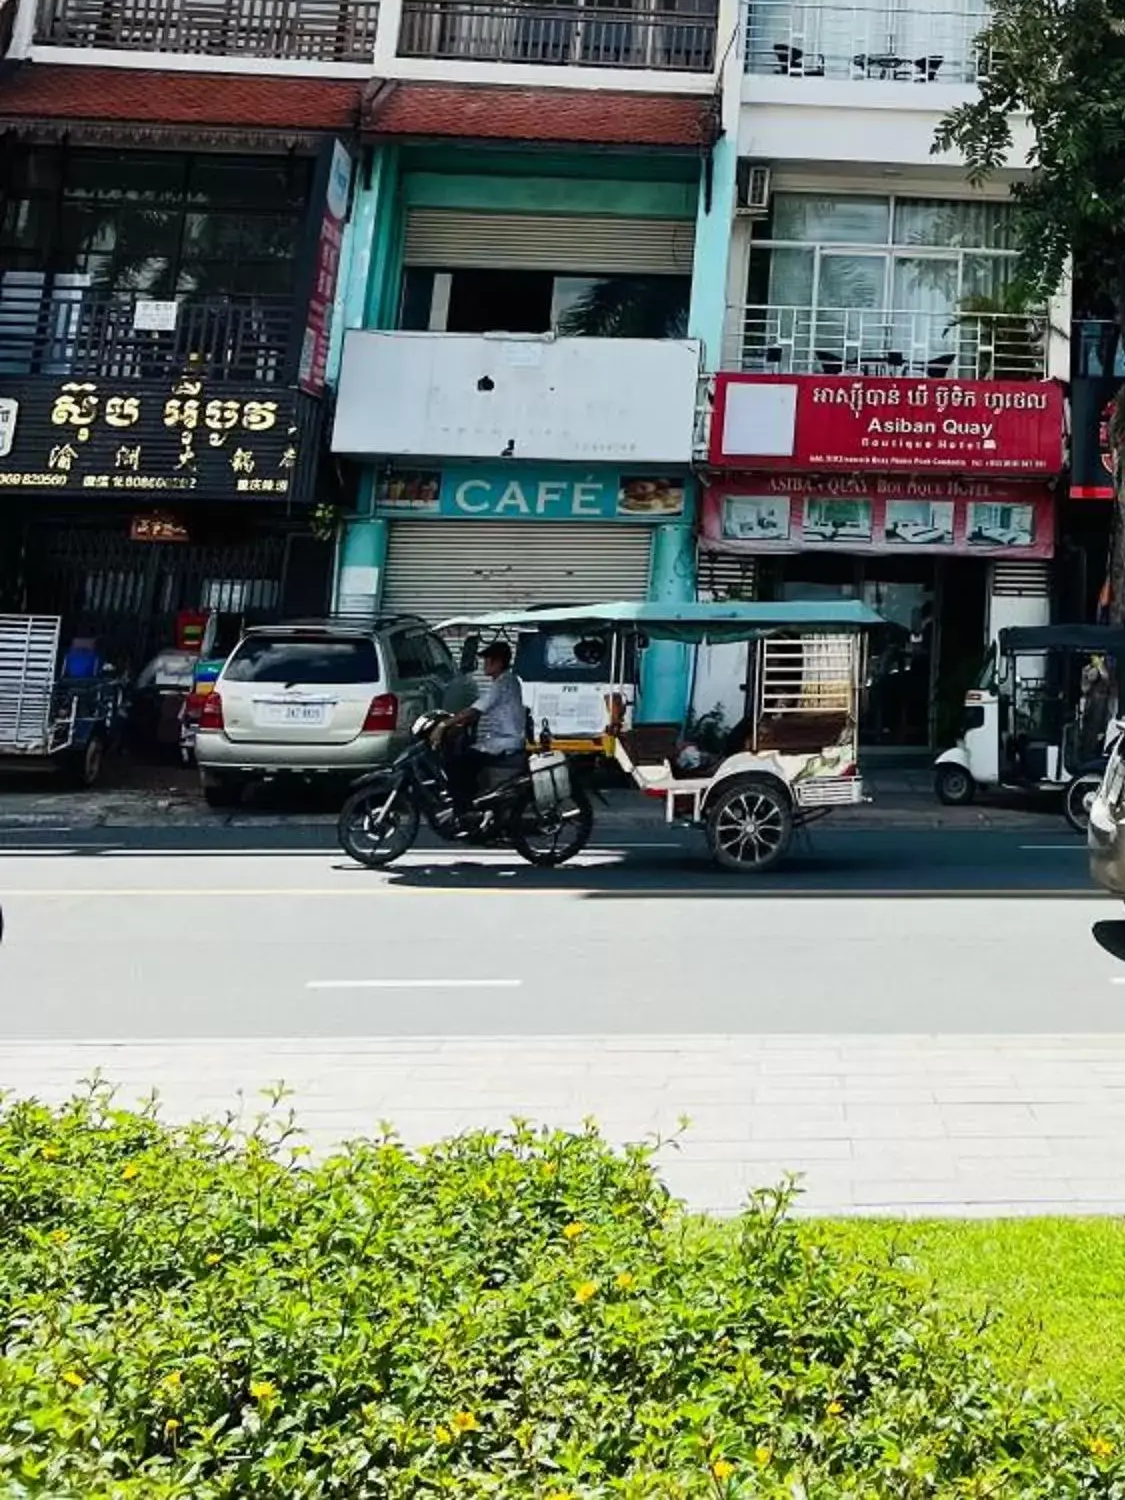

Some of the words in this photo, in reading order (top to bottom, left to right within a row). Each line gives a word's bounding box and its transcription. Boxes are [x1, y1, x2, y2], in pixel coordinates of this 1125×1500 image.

[866, 417, 936, 434] Asiban
[942, 419, 993, 439] Quay
[455, 475, 603, 516] CAFÉ
